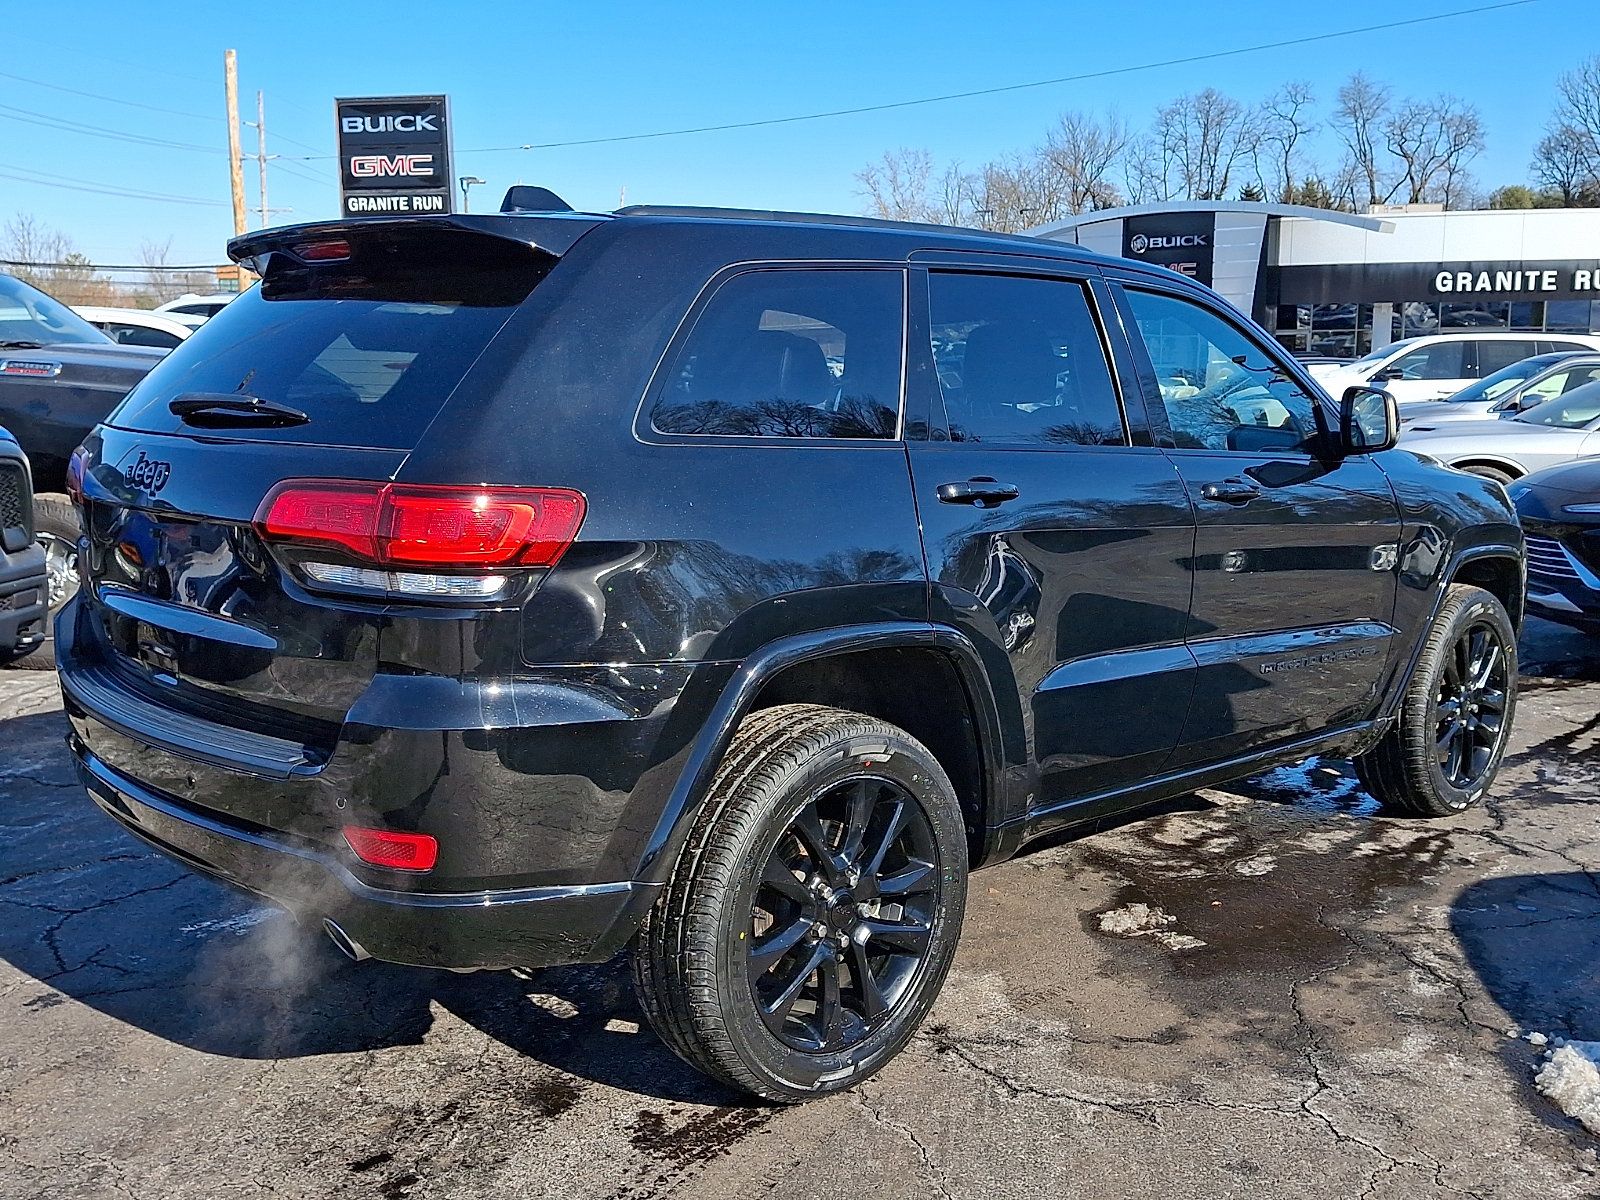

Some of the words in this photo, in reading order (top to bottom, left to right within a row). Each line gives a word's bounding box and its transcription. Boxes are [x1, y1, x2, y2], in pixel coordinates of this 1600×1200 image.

[342, 114, 438, 133] BUICK
[351, 154, 434, 177] GMC
[348, 196, 409, 211] GRANITE
[413, 195, 443, 211] RUN
[1149, 234, 1208, 248] BUICK
[1435, 270, 1558, 293] GRANITE
[124, 451, 172, 498] Jeep
